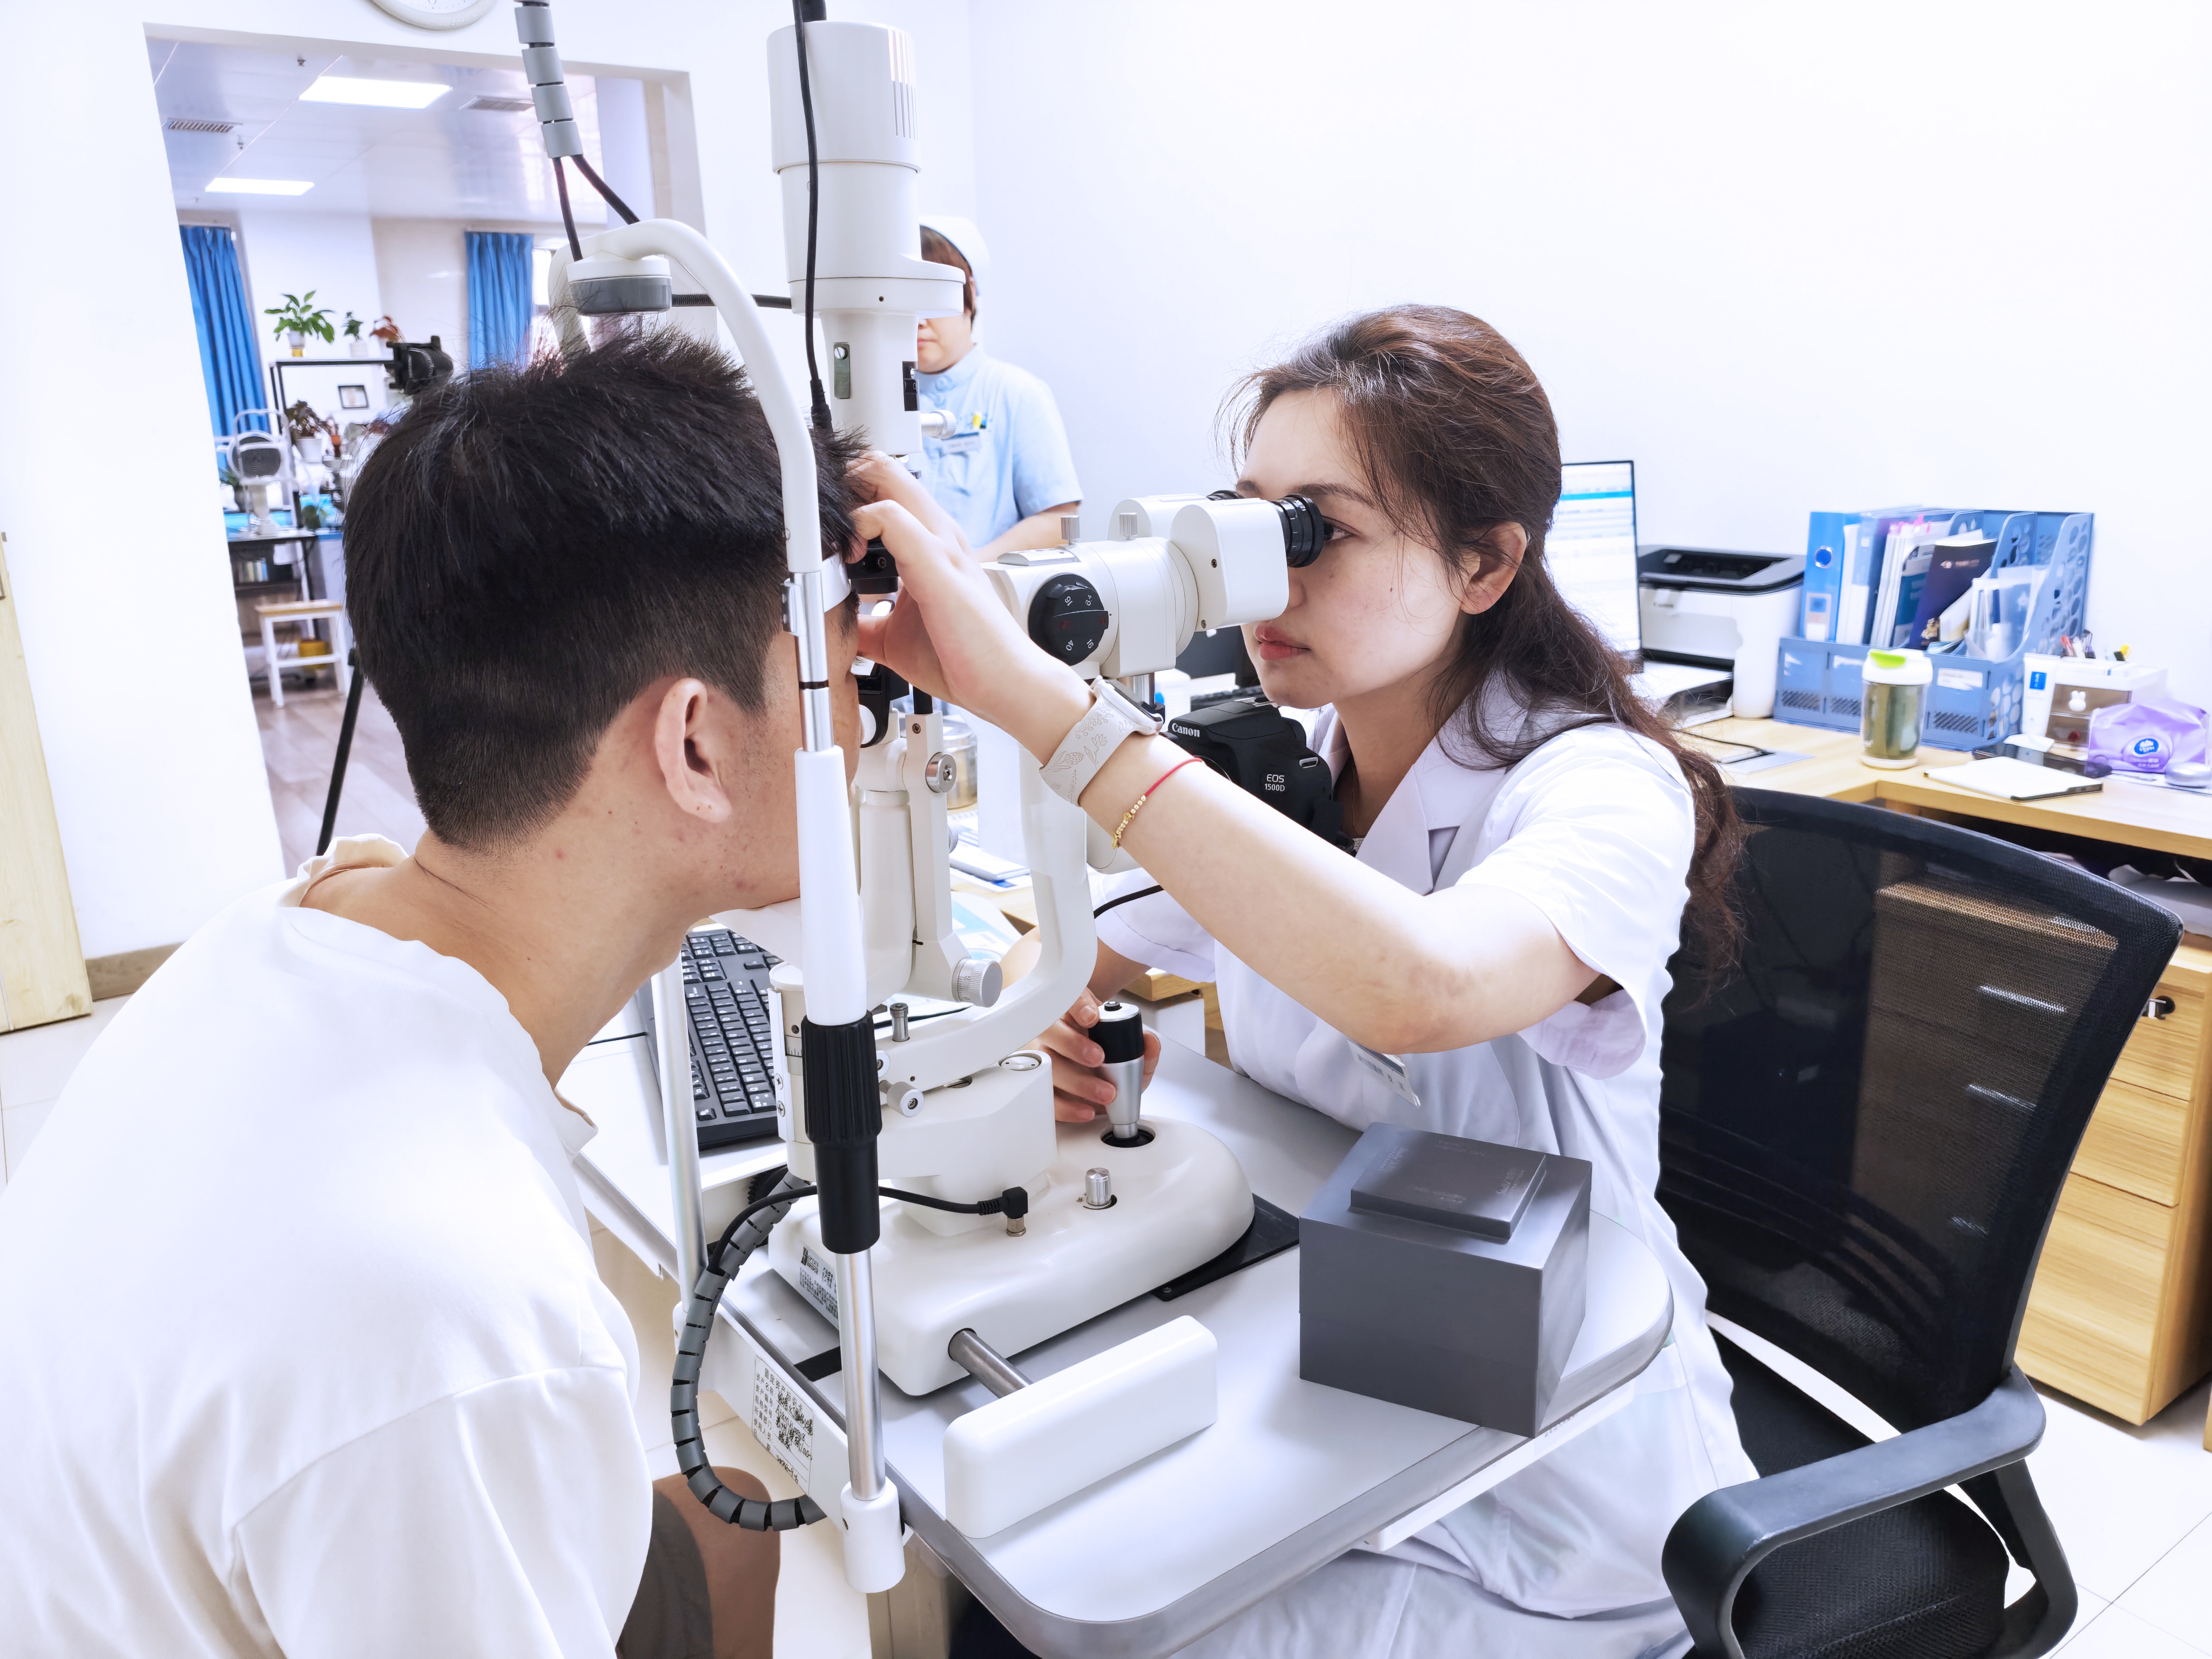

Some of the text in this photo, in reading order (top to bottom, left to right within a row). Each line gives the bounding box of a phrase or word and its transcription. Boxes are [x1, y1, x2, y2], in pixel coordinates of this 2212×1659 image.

[1065, 639, 1074, 651] 40
[1172, 723, 1200, 738] Canon
[1266, 774, 1285, 783] EOS
[1264, 783, 1285, 792] 1500D
